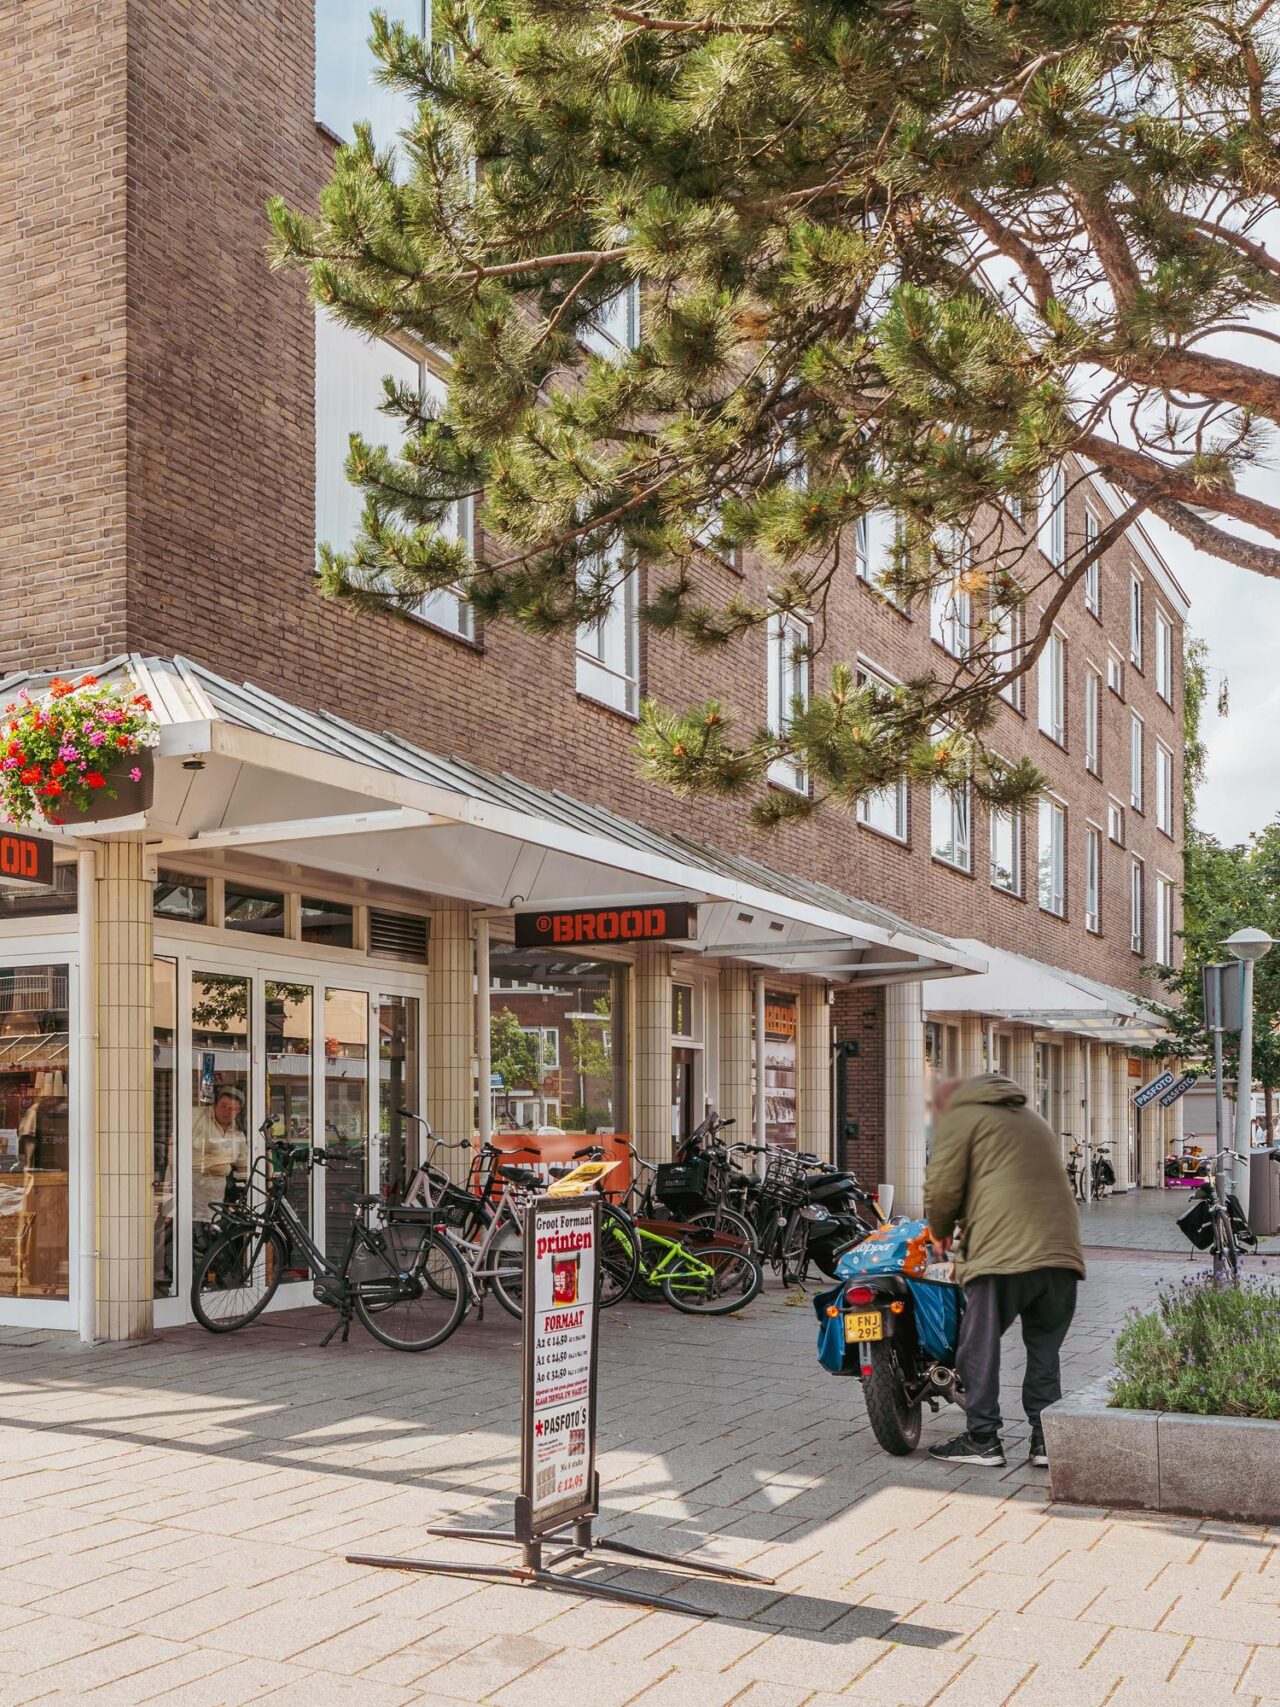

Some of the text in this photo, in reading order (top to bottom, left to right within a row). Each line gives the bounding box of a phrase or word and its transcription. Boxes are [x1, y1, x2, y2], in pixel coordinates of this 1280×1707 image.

[553, 908, 666, 942] BROOD
[1136, 1075, 1173, 1105] PASFOTO
[1162, 1077, 1194, 1105] PASFOTO
[536, 1214, 592, 1230] Groot Formaat
[536, 1229, 592, 1260] printen
[544, 1310, 584, 1331] FORMAAT
[858, 1315, 878, 1327] FNJ
[536, 1338, 545, 1349] A2
[536, 1354, 545, 1366] A1
